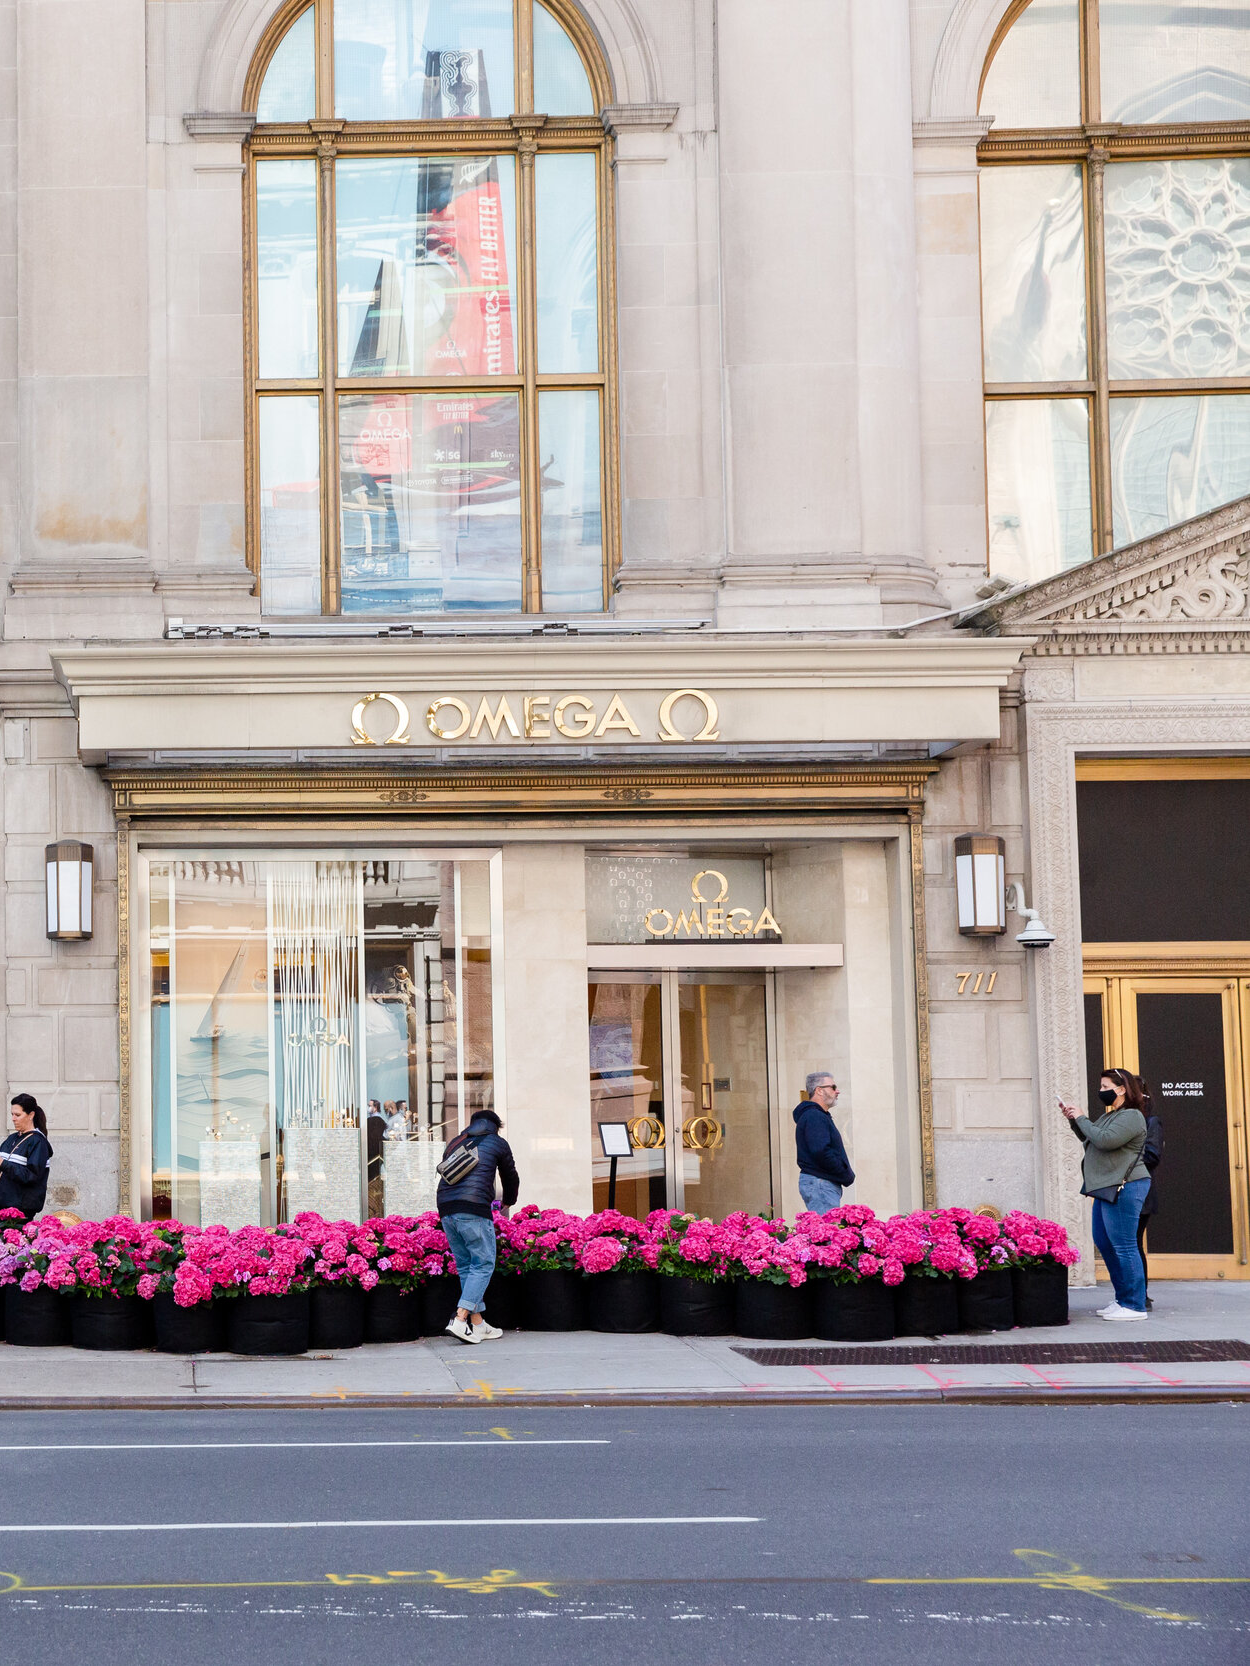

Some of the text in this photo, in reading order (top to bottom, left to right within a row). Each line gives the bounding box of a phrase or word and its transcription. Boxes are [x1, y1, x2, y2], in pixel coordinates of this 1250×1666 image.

[478, 196, 501, 376] mirates FLY BETTER
[435, 349, 467, 358] OMEGA
[436, 402, 474, 412] Emirates
[359, 428, 412, 442] OMEGA
[426, 693, 642, 740] OMEGA
[644, 906, 783, 936] OMEGA
[955, 971, 999, 995] 711
[287, 1032, 351, 1047] OMEGA
